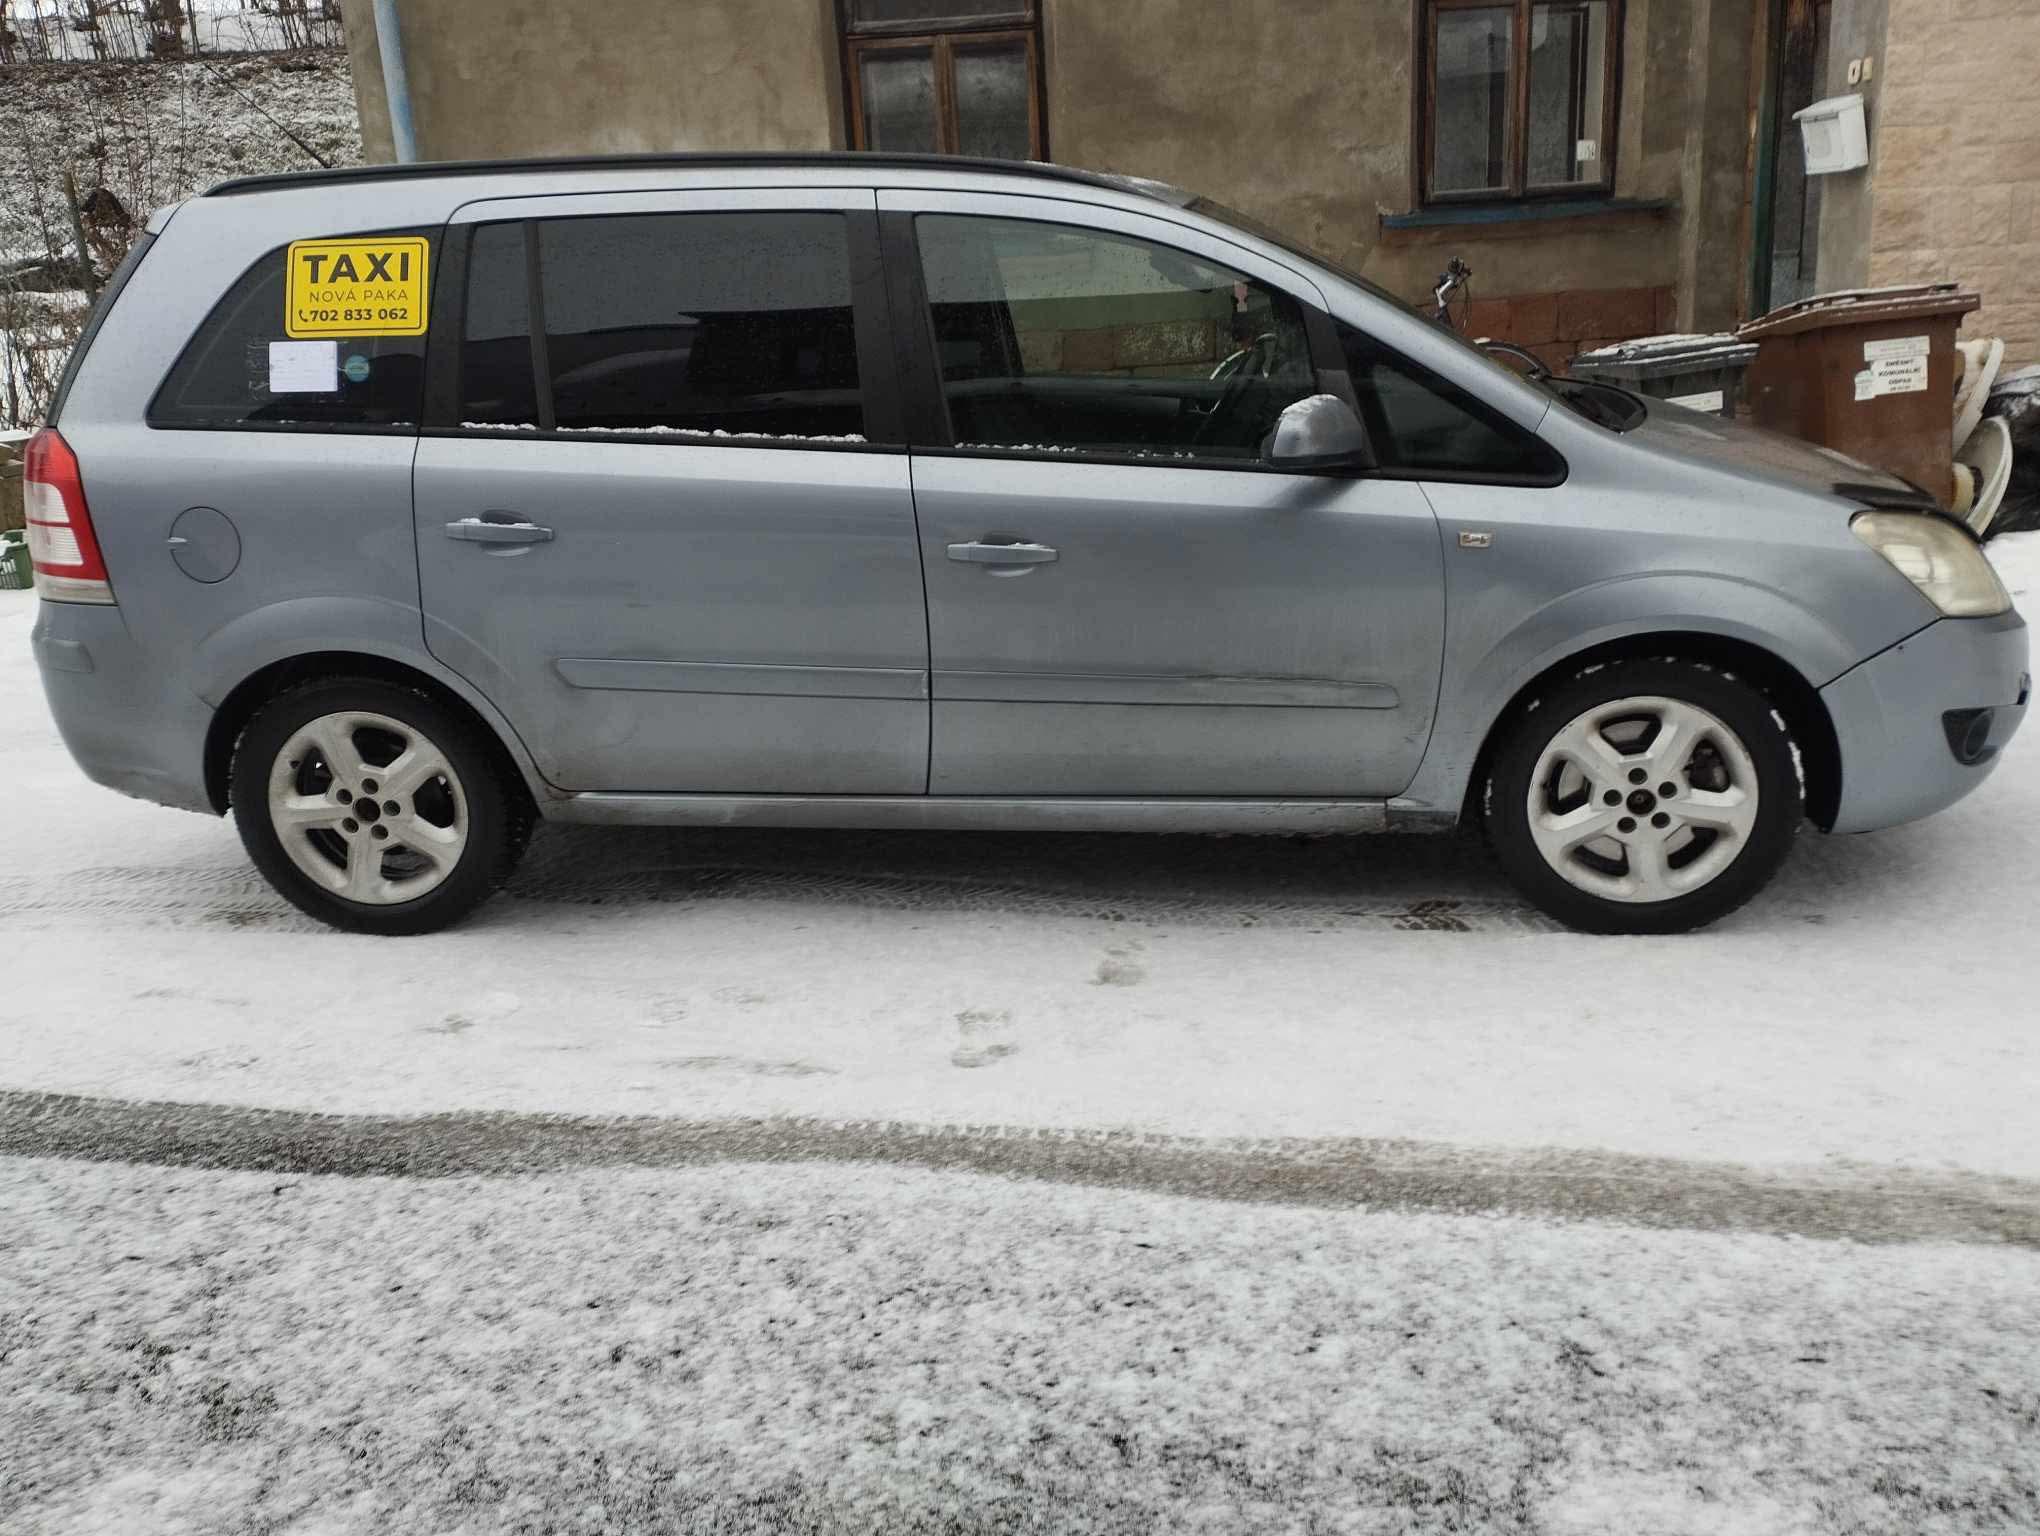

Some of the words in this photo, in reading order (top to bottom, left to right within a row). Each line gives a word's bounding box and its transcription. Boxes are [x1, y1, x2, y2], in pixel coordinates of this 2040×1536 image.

[302, 252, 410, 284] TAXI
[363, 289, 408, 302] PAKA
[310, 309, 339, 322] 702
[343, 308, 373, 321] 833
[378, 307, 408, 320] 062
